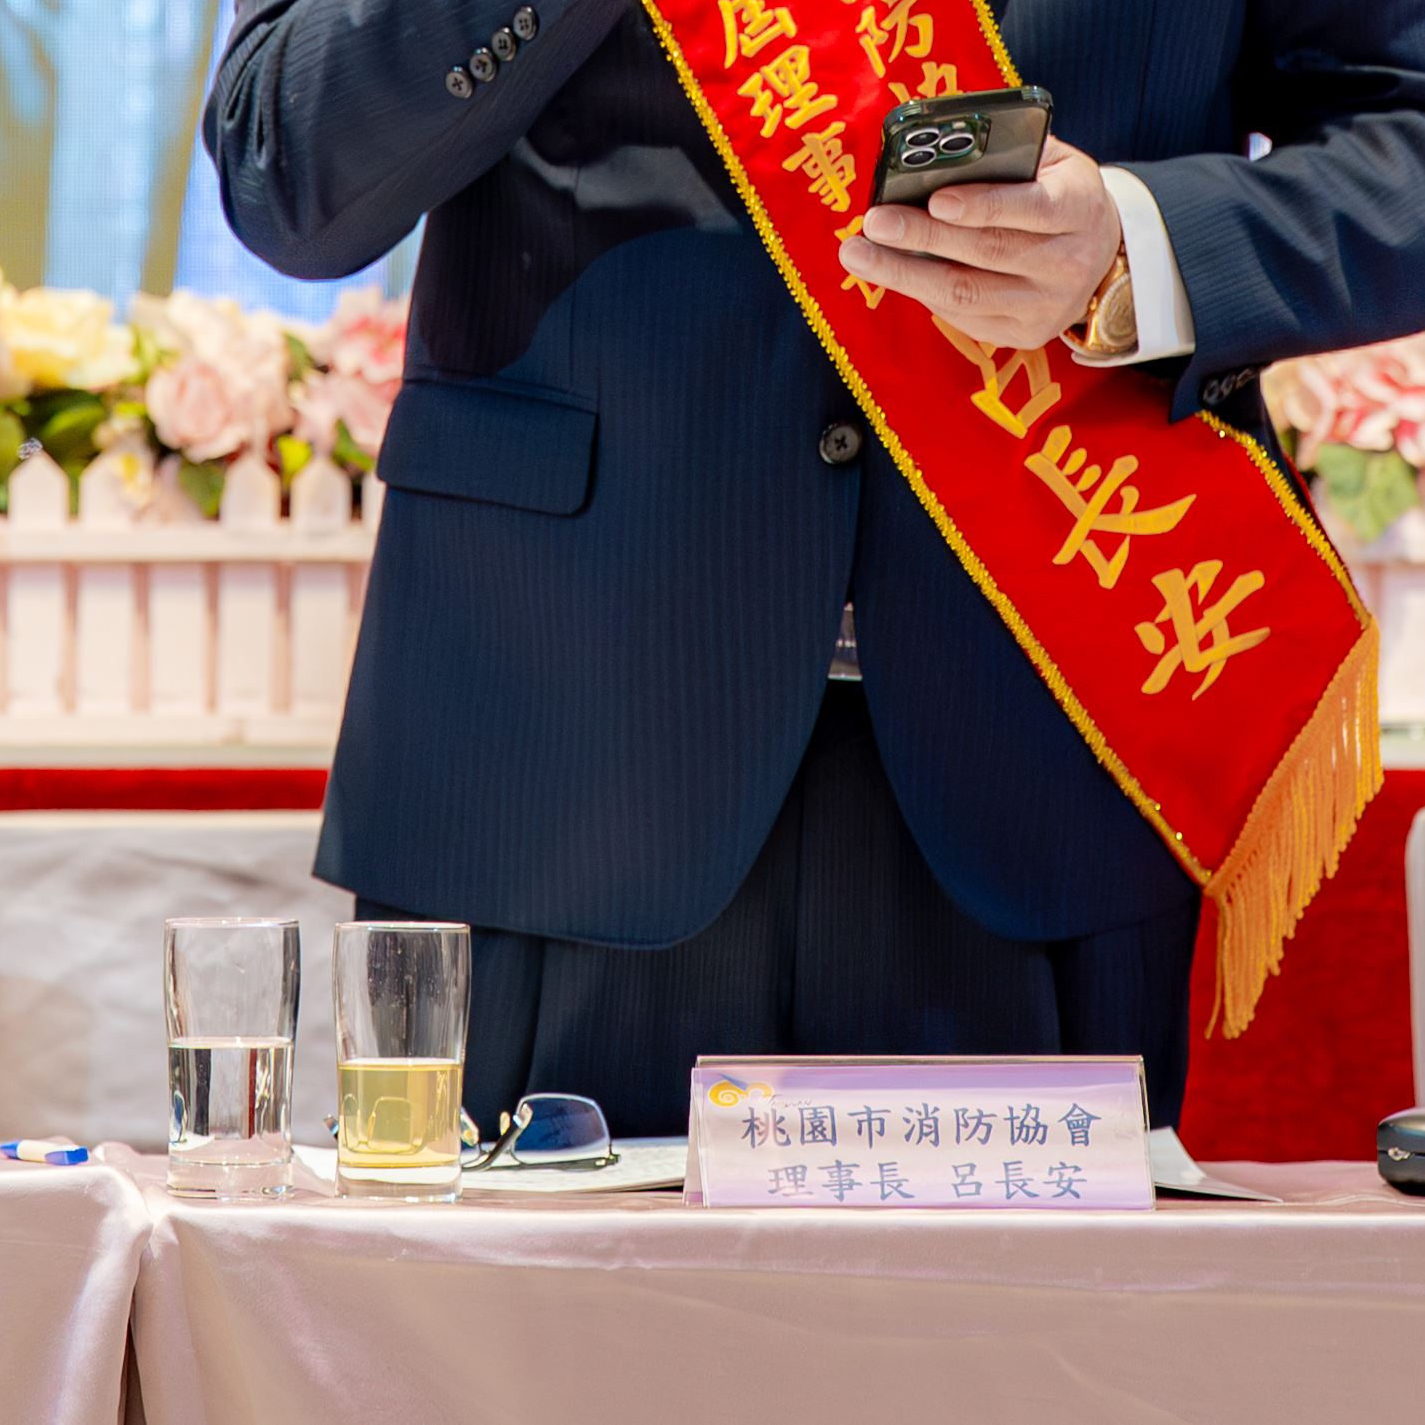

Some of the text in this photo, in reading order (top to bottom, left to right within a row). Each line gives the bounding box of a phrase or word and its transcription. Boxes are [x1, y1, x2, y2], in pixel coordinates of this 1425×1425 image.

[740, 1101, 1102, 1151] 桃園市消防協會
[767, 1159, 1089, 1202] 理事長 呂長安
